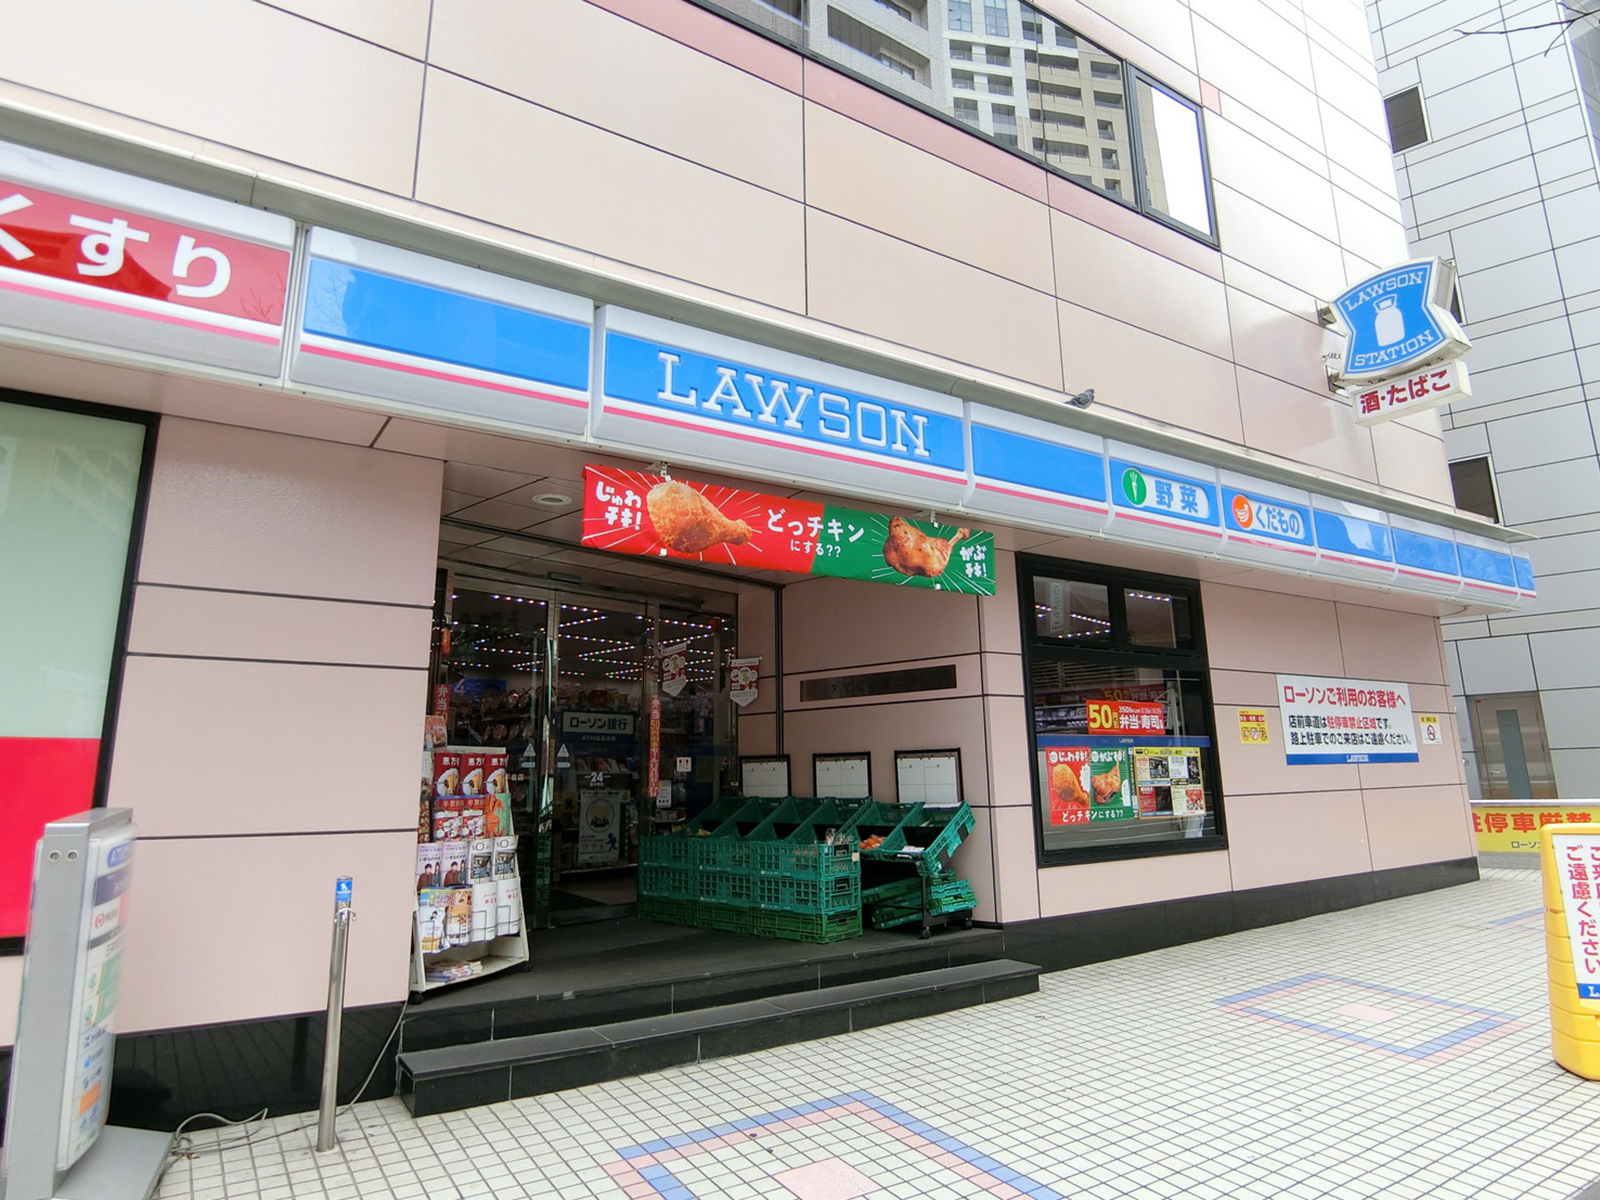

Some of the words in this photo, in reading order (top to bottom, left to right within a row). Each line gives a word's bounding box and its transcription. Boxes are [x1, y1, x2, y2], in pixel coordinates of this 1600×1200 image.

[0, 193, 231, 298] くすり
[1344, 271, 1424, 311] LAWSON
[1354, 329, 1435, 367] STATION
[657, 351, 930, 458] LAWSON
[1360, 369, 1451, 414] 酒・たばこ
[596, 481, 642, 509] じゅわ
[1154, 479, 1199, 514] 野菜
[767, 508, 865, 543] どっチキン
[1255, 506, 1300, 535] くだもの
[790, 539, 841, 558] にする??
[959, 544, 987, 562] がぶ
[1283, 685, 1406, 709] ローソンご利用のお客様へ
[570, 717, 628, 730] ローソン銀行
[1288, 714, 1393, 730] 店前車道は駐停車禁止区域です。
[1290, 732, 1412, 746] 路上駐車でのご来店はご遠慮ください。
[590, 772, 604, 782] 24
[1061, 809, 1124, 824] どっチキンにする??
[1567, 845, 1600, 974] ご遠慮ください
